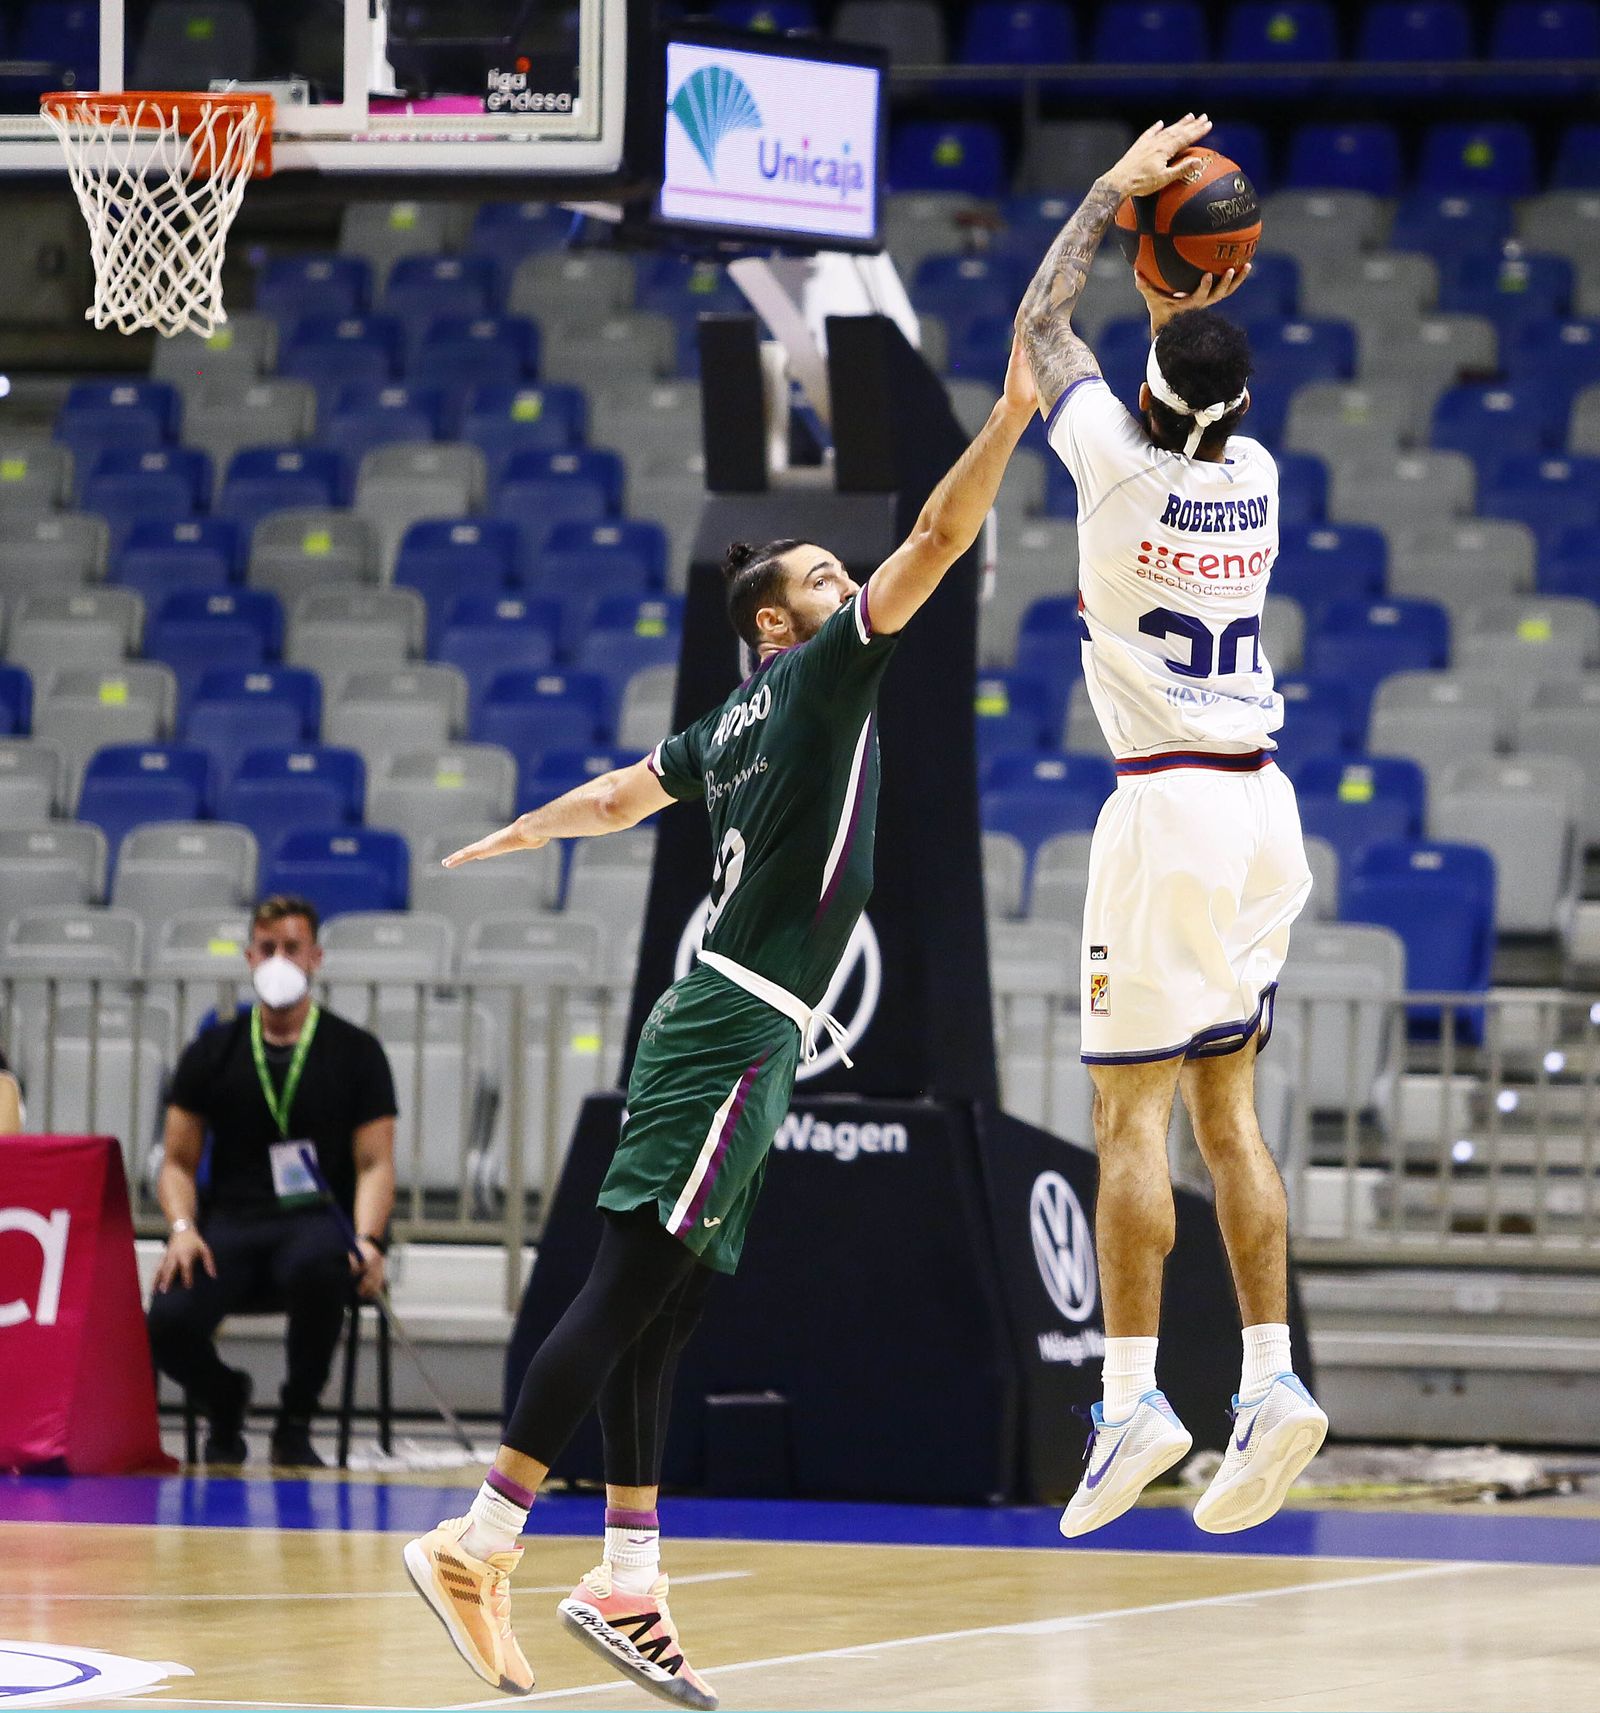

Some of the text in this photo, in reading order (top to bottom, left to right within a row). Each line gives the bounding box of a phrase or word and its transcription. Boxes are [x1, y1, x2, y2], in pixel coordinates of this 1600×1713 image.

[488, 67, 527, 93] liga
[487, 89, 571, 111] endesa
[758, 136, 864, 199] Unicaja
[1160, 493, 1268, 532] ROBERTSON
